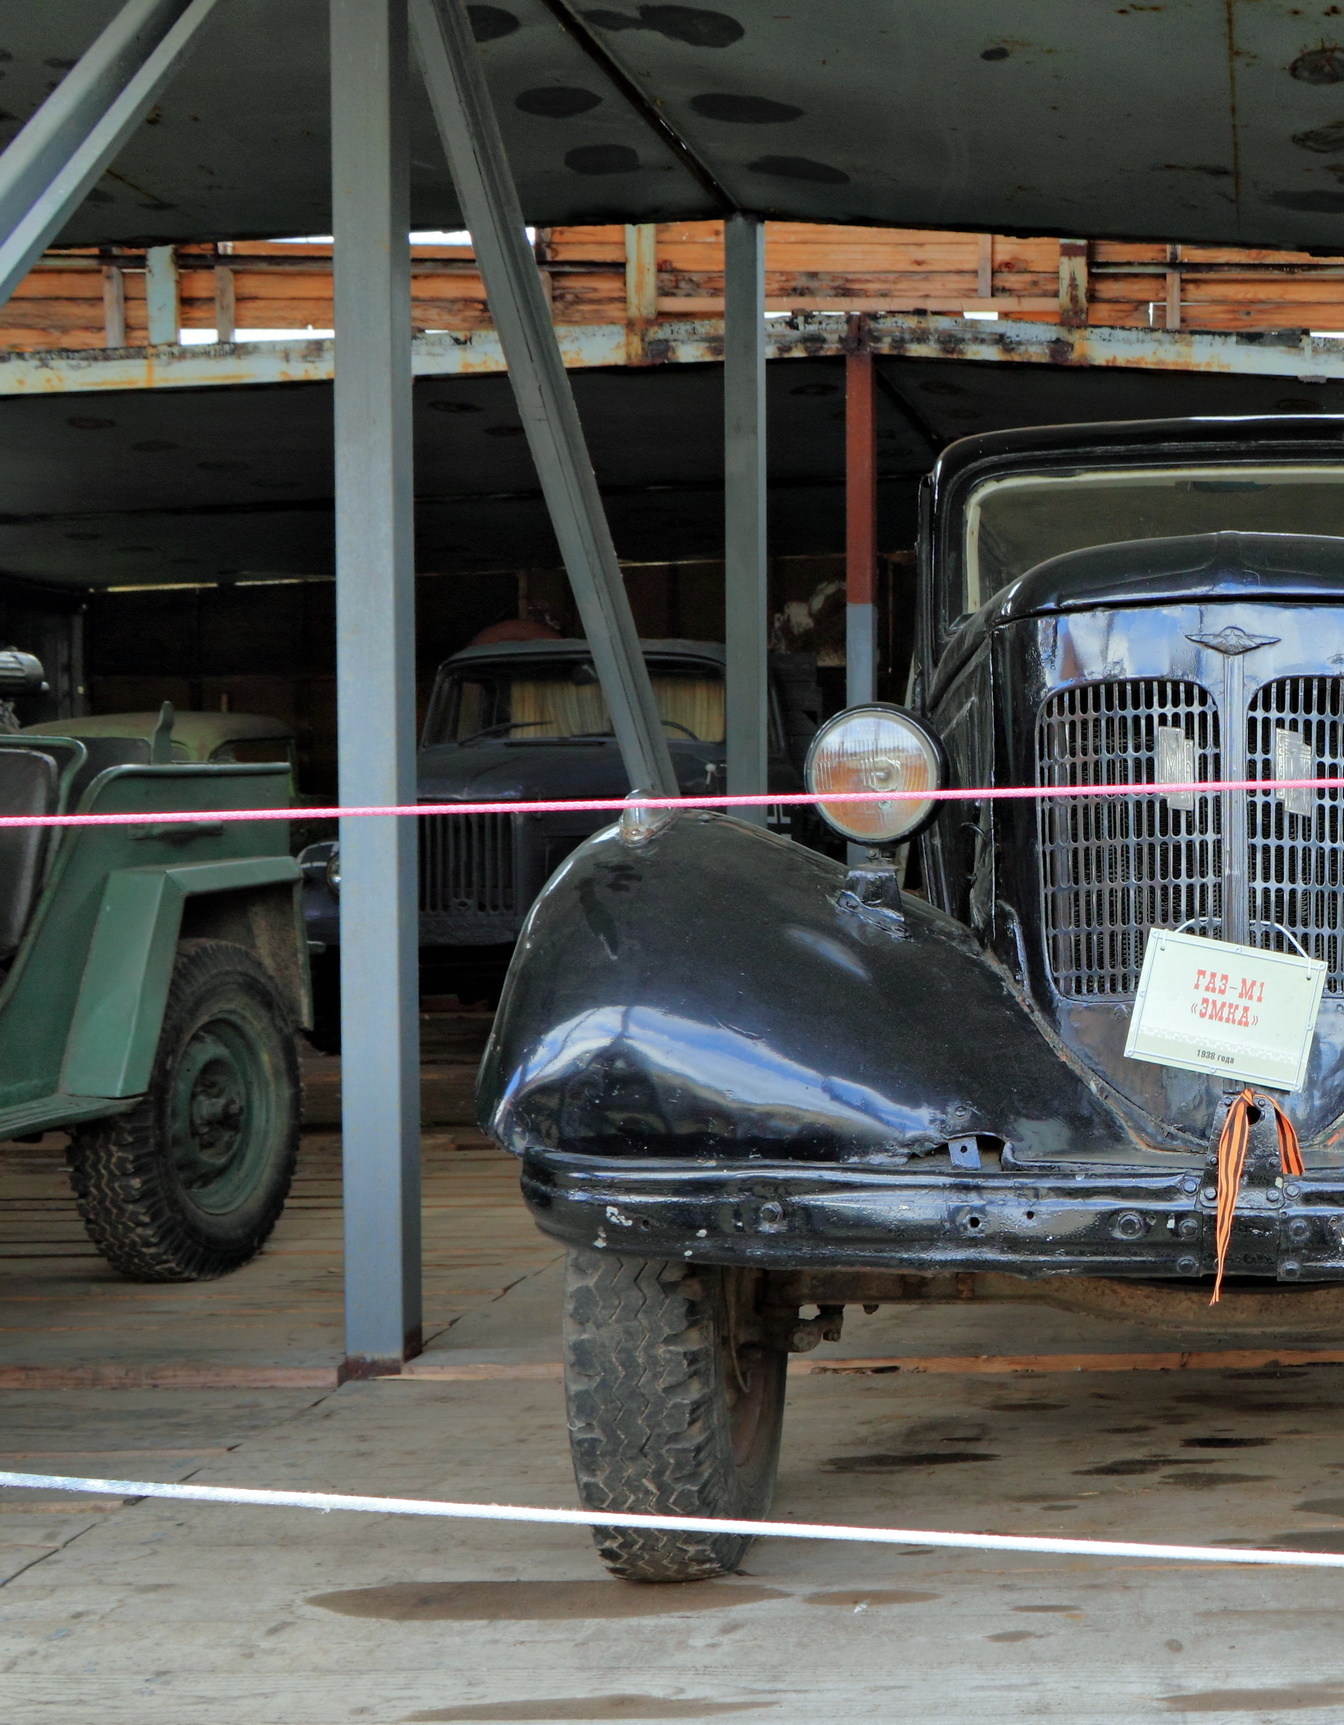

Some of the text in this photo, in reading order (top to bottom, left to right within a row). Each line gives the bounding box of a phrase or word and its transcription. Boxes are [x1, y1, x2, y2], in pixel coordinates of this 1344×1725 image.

[1194, 969, 1264, 1002] ГАЗ-М1
[1197, 1049, 1235, 1065] 1938 года
